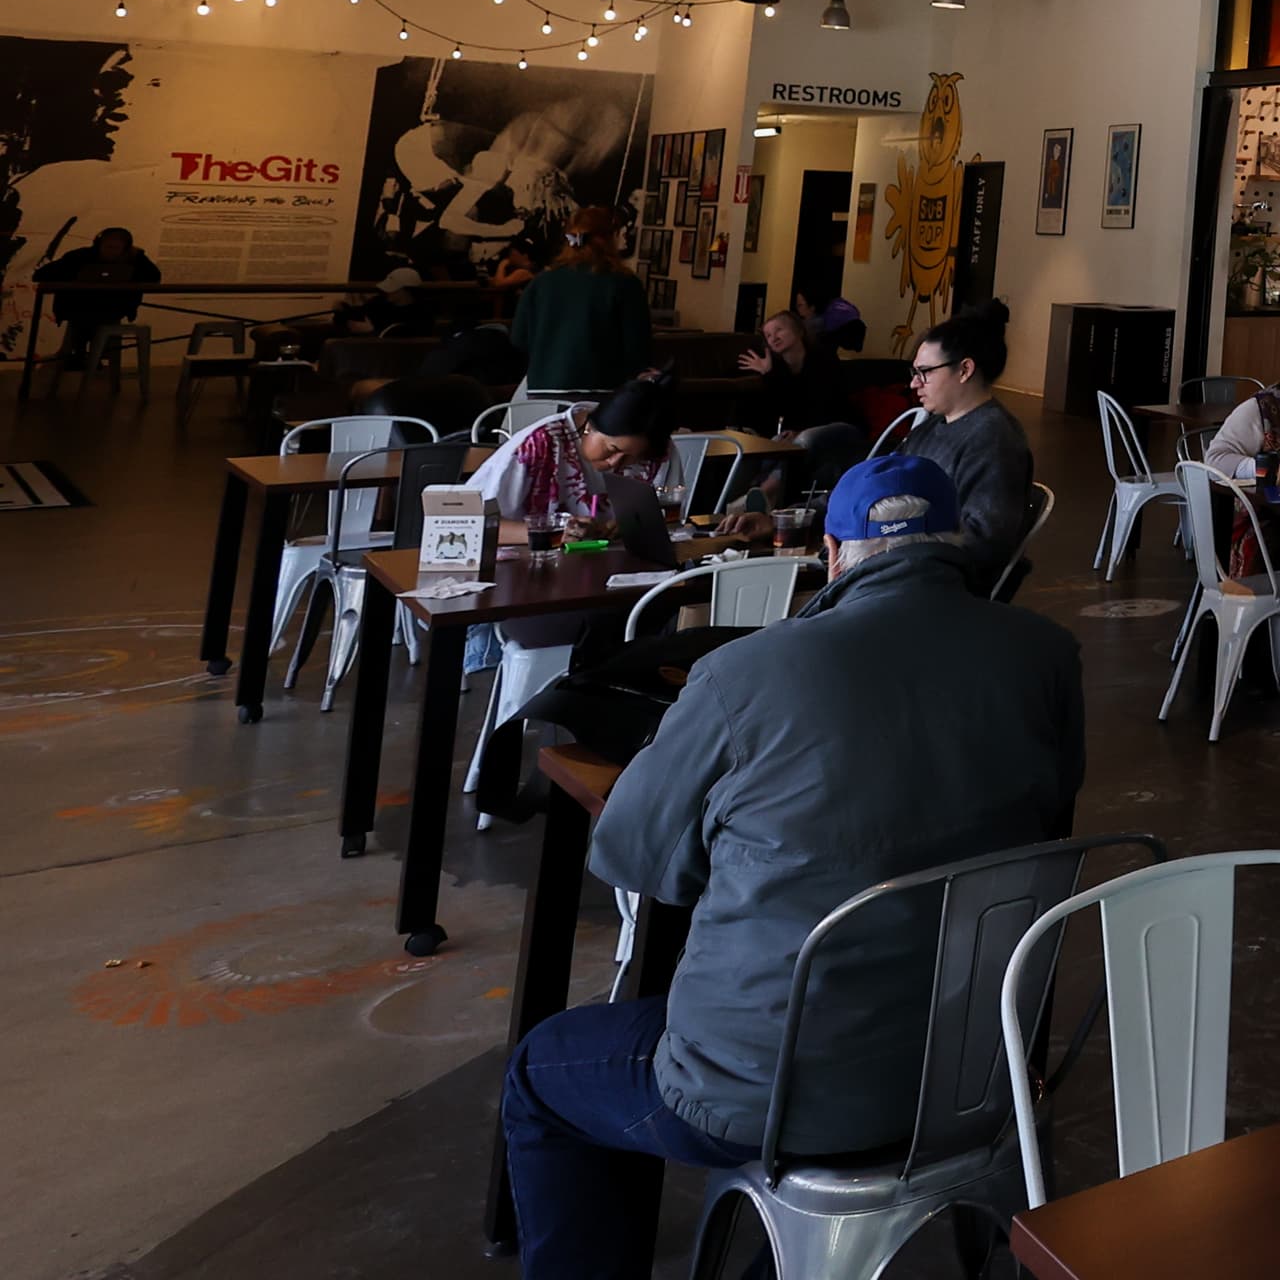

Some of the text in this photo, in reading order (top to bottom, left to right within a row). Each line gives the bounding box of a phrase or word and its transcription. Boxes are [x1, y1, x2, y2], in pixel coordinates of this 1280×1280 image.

[772, 83, 901, 108] RESTROOMS
[260, 155, 340, 184] Gits
[919, 199, 945, 220] SUB
[970, 177, 987, 264] STAFF ONLY
[919, 224, 944, 245] POP
